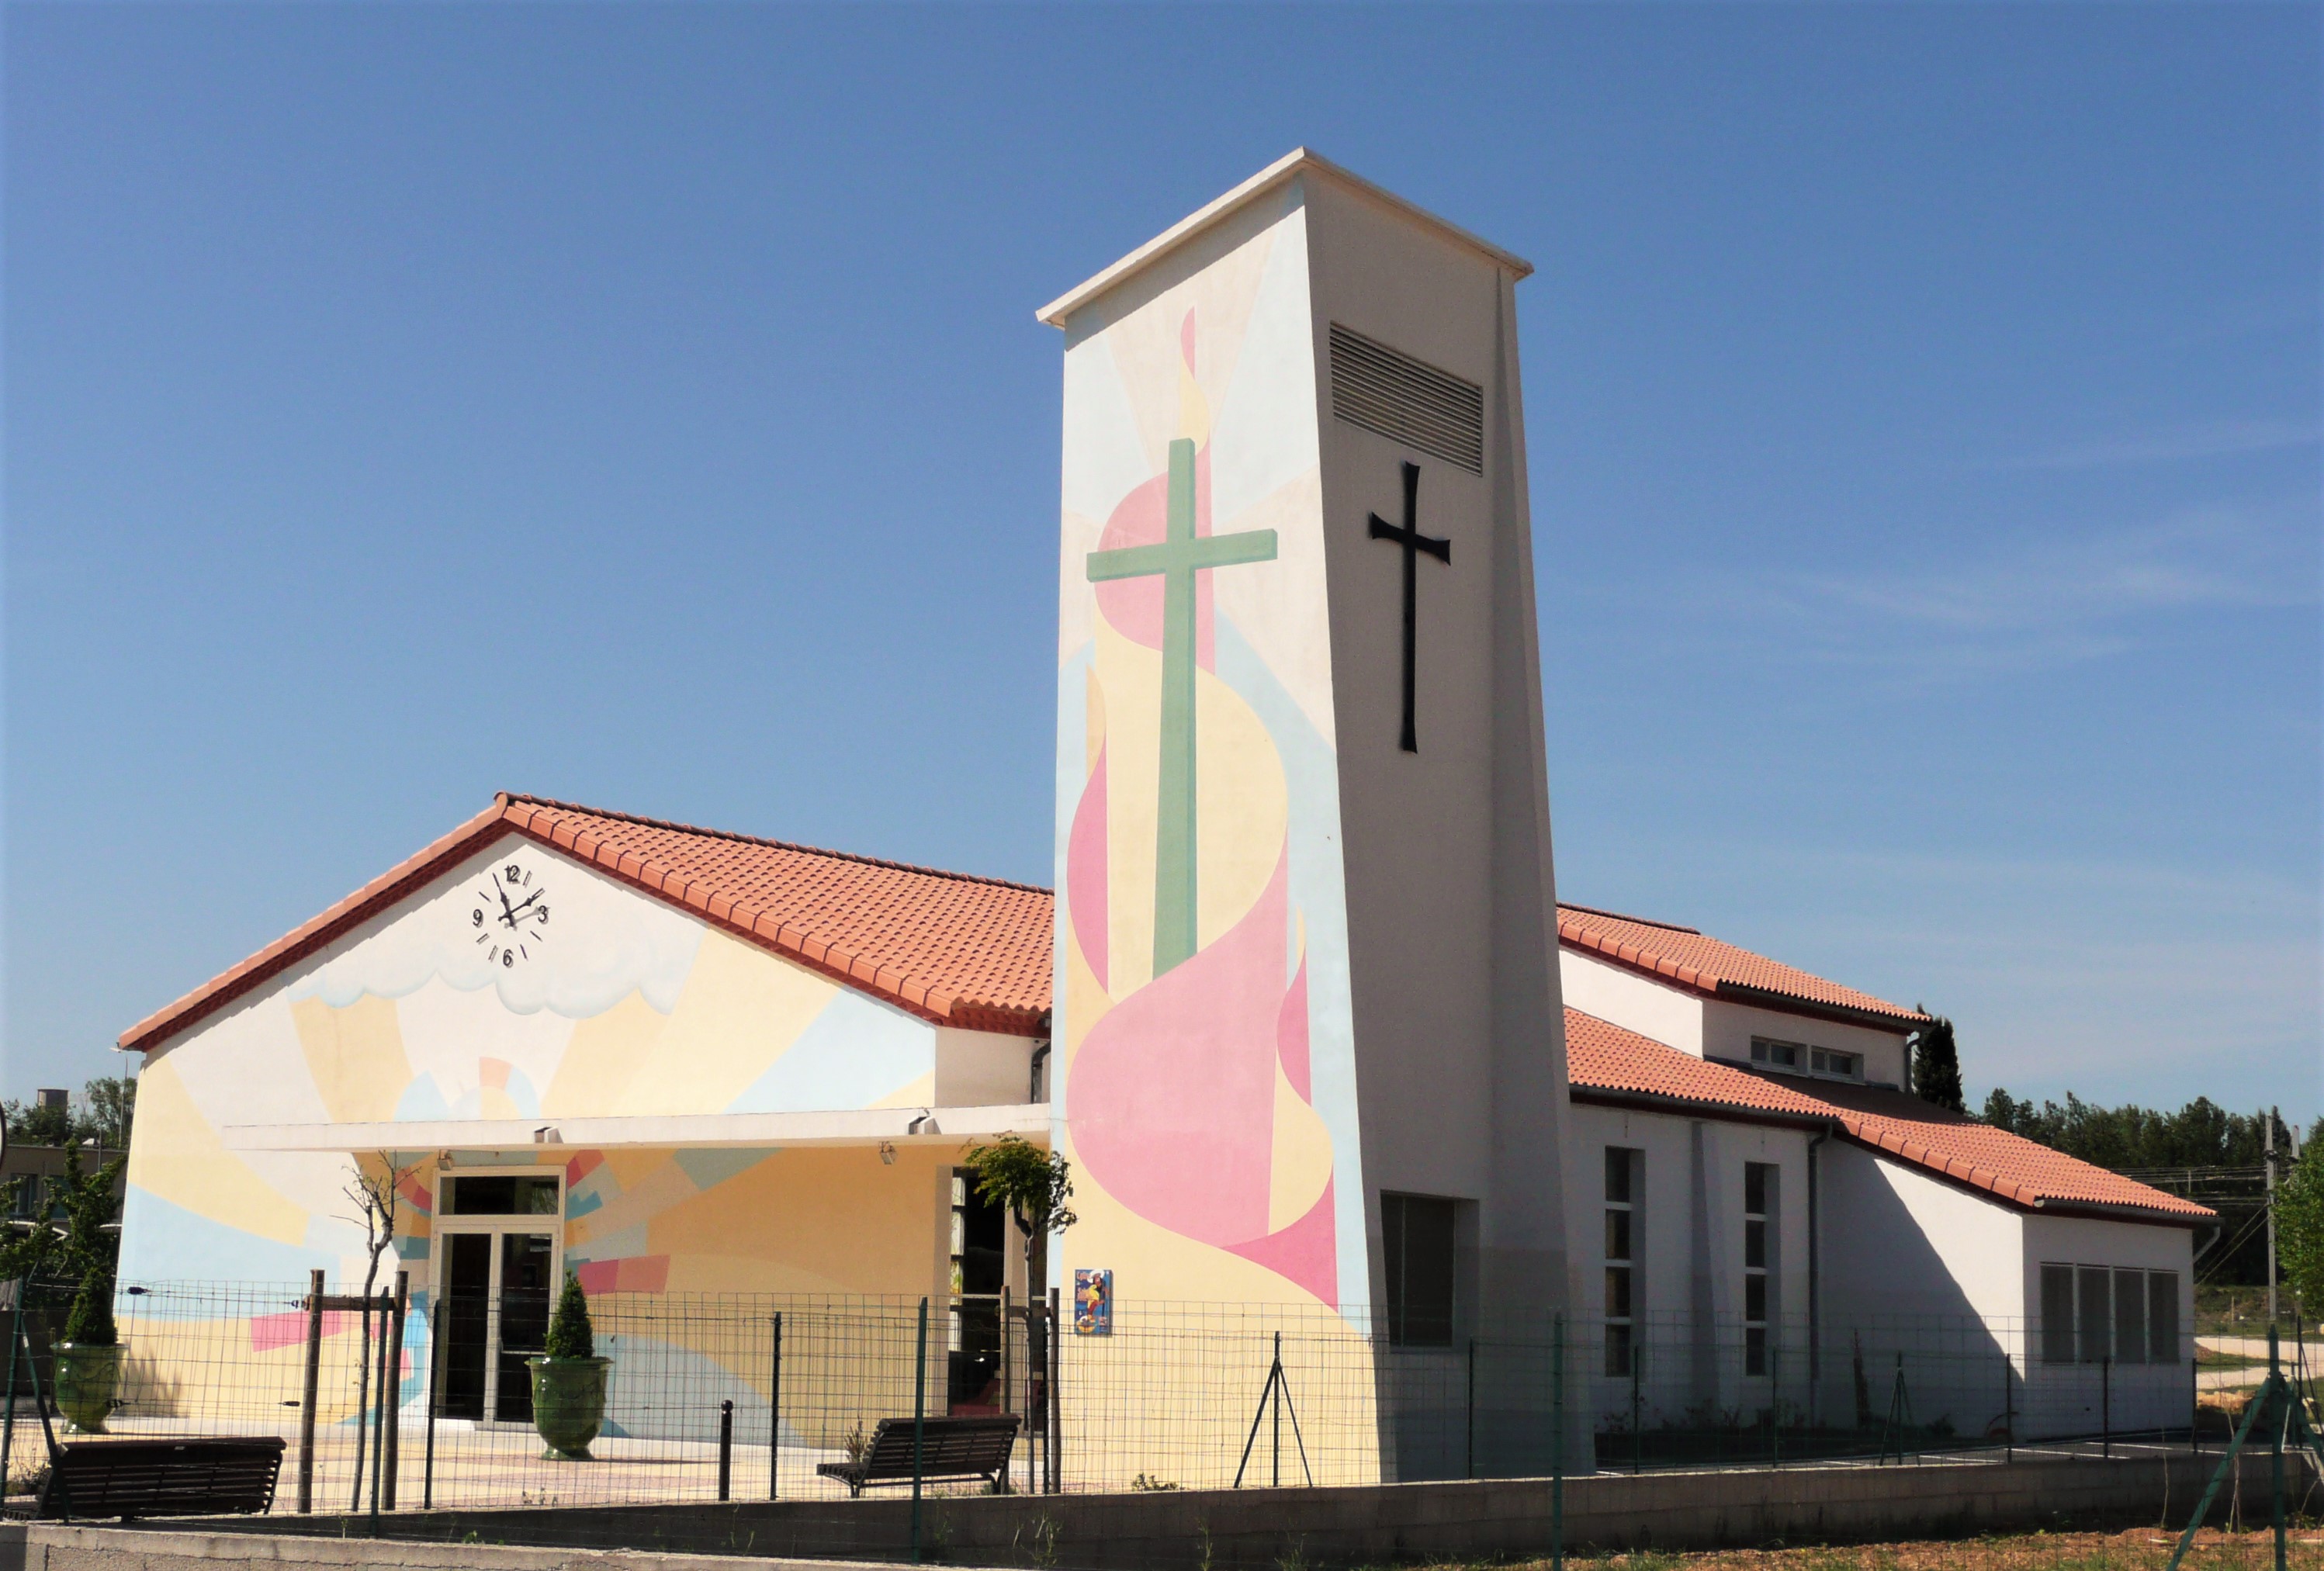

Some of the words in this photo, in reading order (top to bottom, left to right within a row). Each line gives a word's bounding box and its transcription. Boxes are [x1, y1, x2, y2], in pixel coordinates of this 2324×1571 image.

[504, 865, 521, 883] 12
[473, 909, 483, 926] 9
[538, 905, 548, 923] 3
[503, 949, 513, 966] 6
